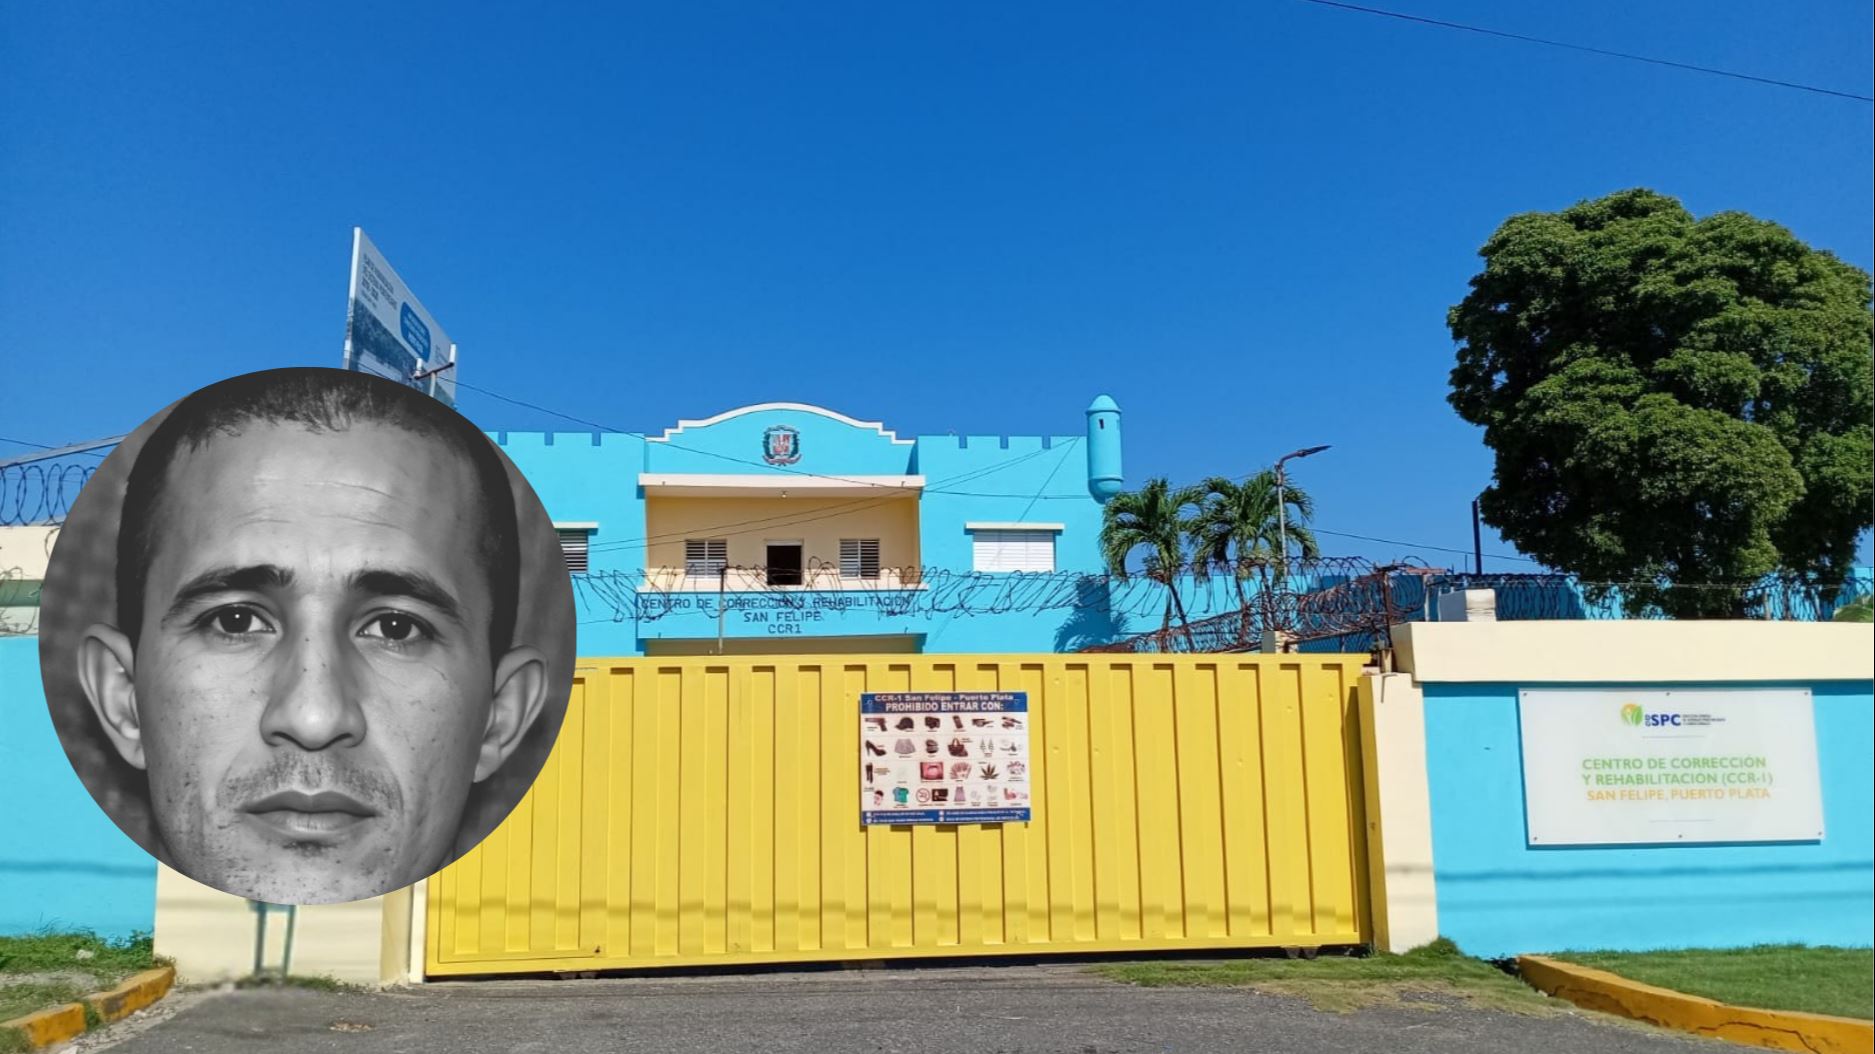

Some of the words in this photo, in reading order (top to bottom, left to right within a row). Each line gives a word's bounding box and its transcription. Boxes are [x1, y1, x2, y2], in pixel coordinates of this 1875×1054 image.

[641, 598, 691, 609] CENTRO
[697, 598, 713, 609] DE
[744, 612, 768, 623] SAN
[777, 611, 821, 623] FELIPE
[768, 624, 802, 634] CCR1
[886, 702, 938, 712] PROHIBIDO
[941, 701, 978, 711] ENTRAR
[981, 701, 1005, 711] CON:
[1651, 714, 1681, 727] SPC
[1582, 758, 1643, 770] CENTRO
[1648, 758, 1666, 769] DE
[1581, 774, 1591, 786] Y
[1587, 790, 1616, 801] SAN
[1671, 788, 1725, 800] PUERTO
[1729, 787, 1771, 800] PLATA
